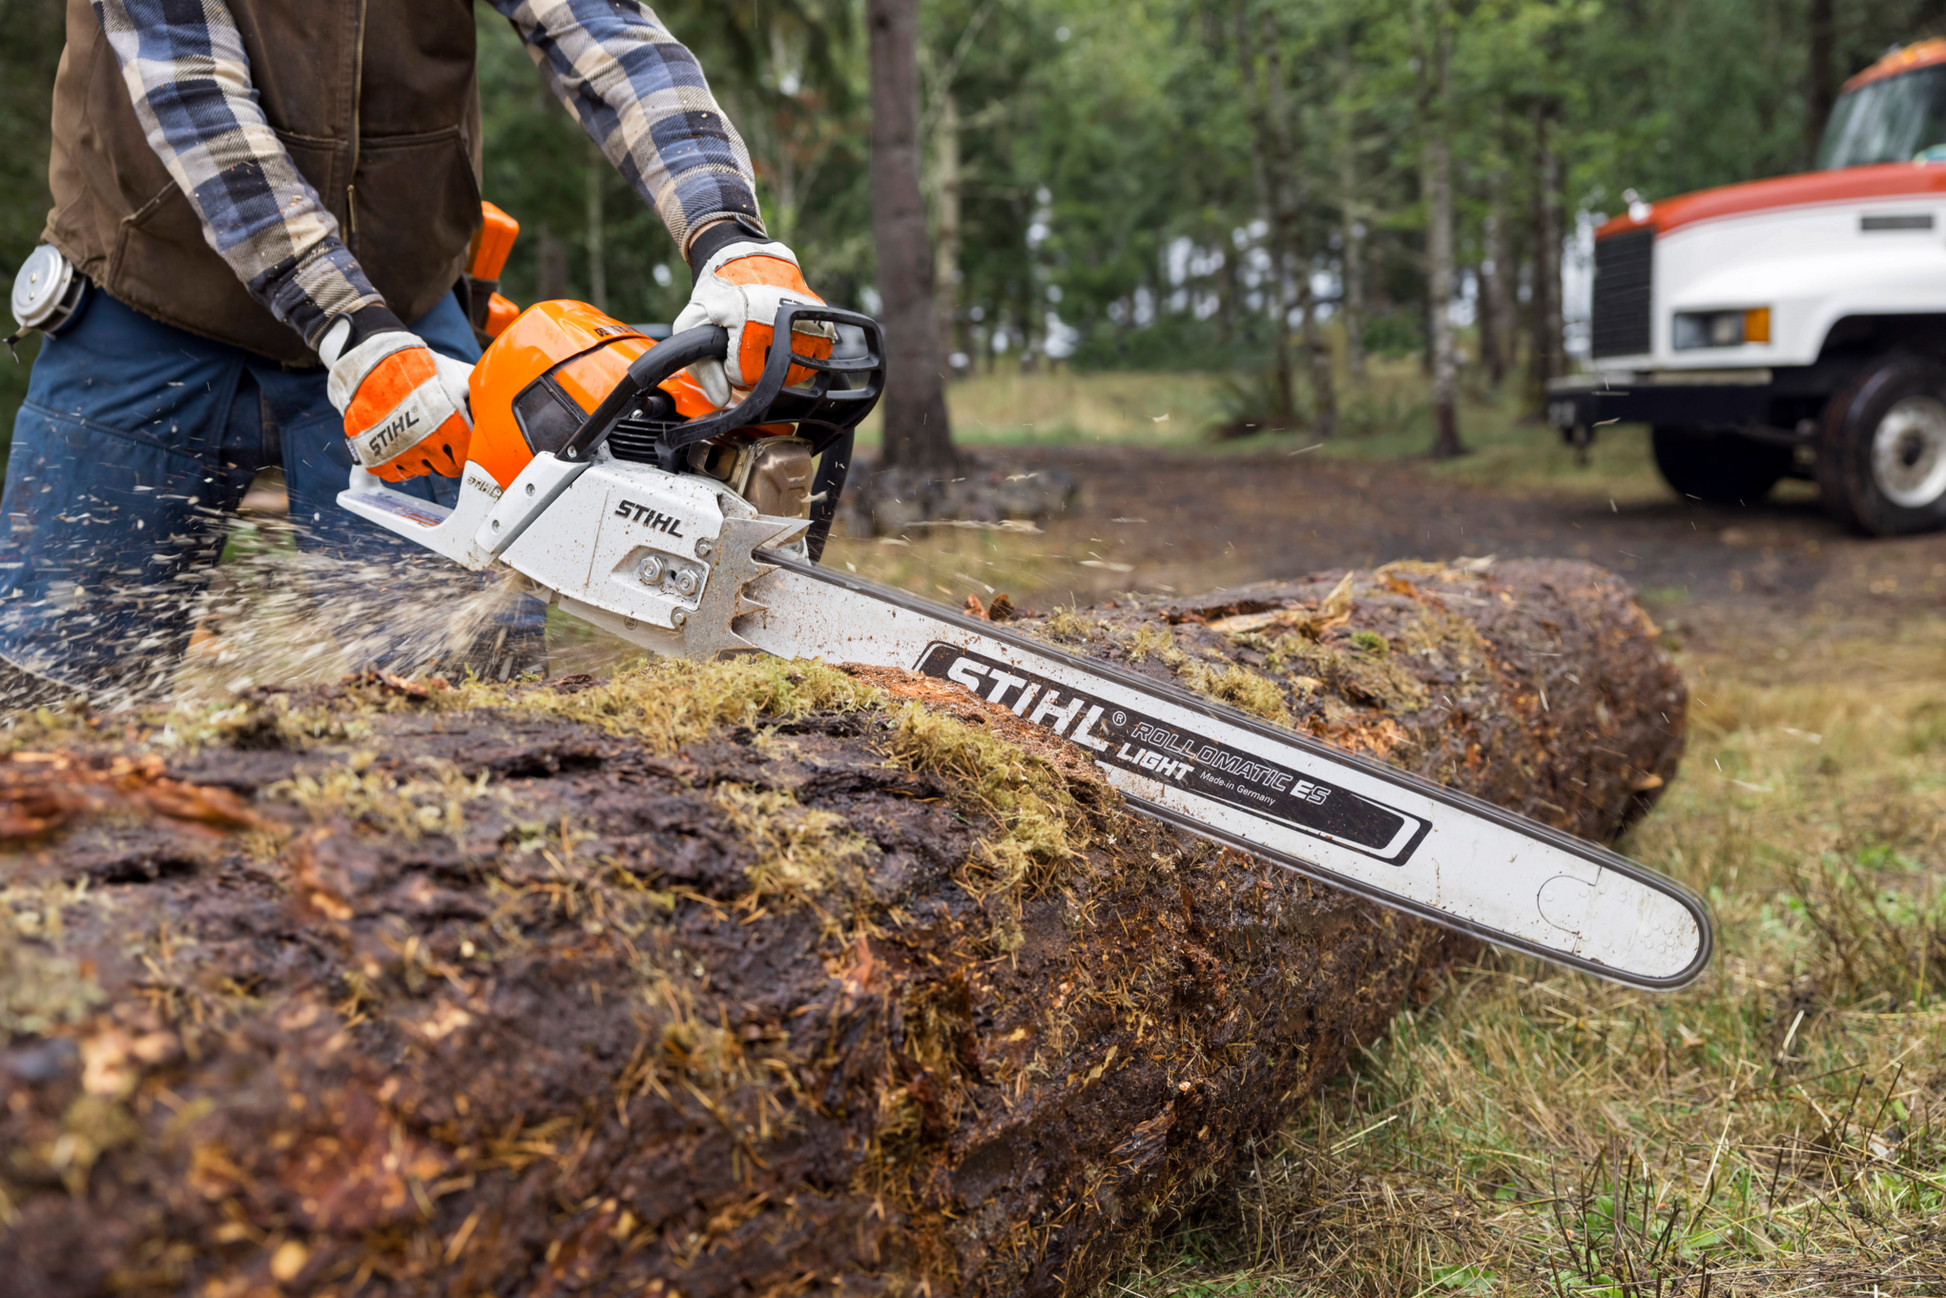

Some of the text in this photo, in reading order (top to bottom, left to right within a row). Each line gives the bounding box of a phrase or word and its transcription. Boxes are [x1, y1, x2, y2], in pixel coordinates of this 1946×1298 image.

[614, 499, 684, 538] STIHL
[1116, 743, 1195, 781] LIGHT
[1131, 721, 1293, 792] ROLLOMATIC
[1289, 779, 1332, 806] ES
[1200, 771, 1277, 807] Made in Germany
